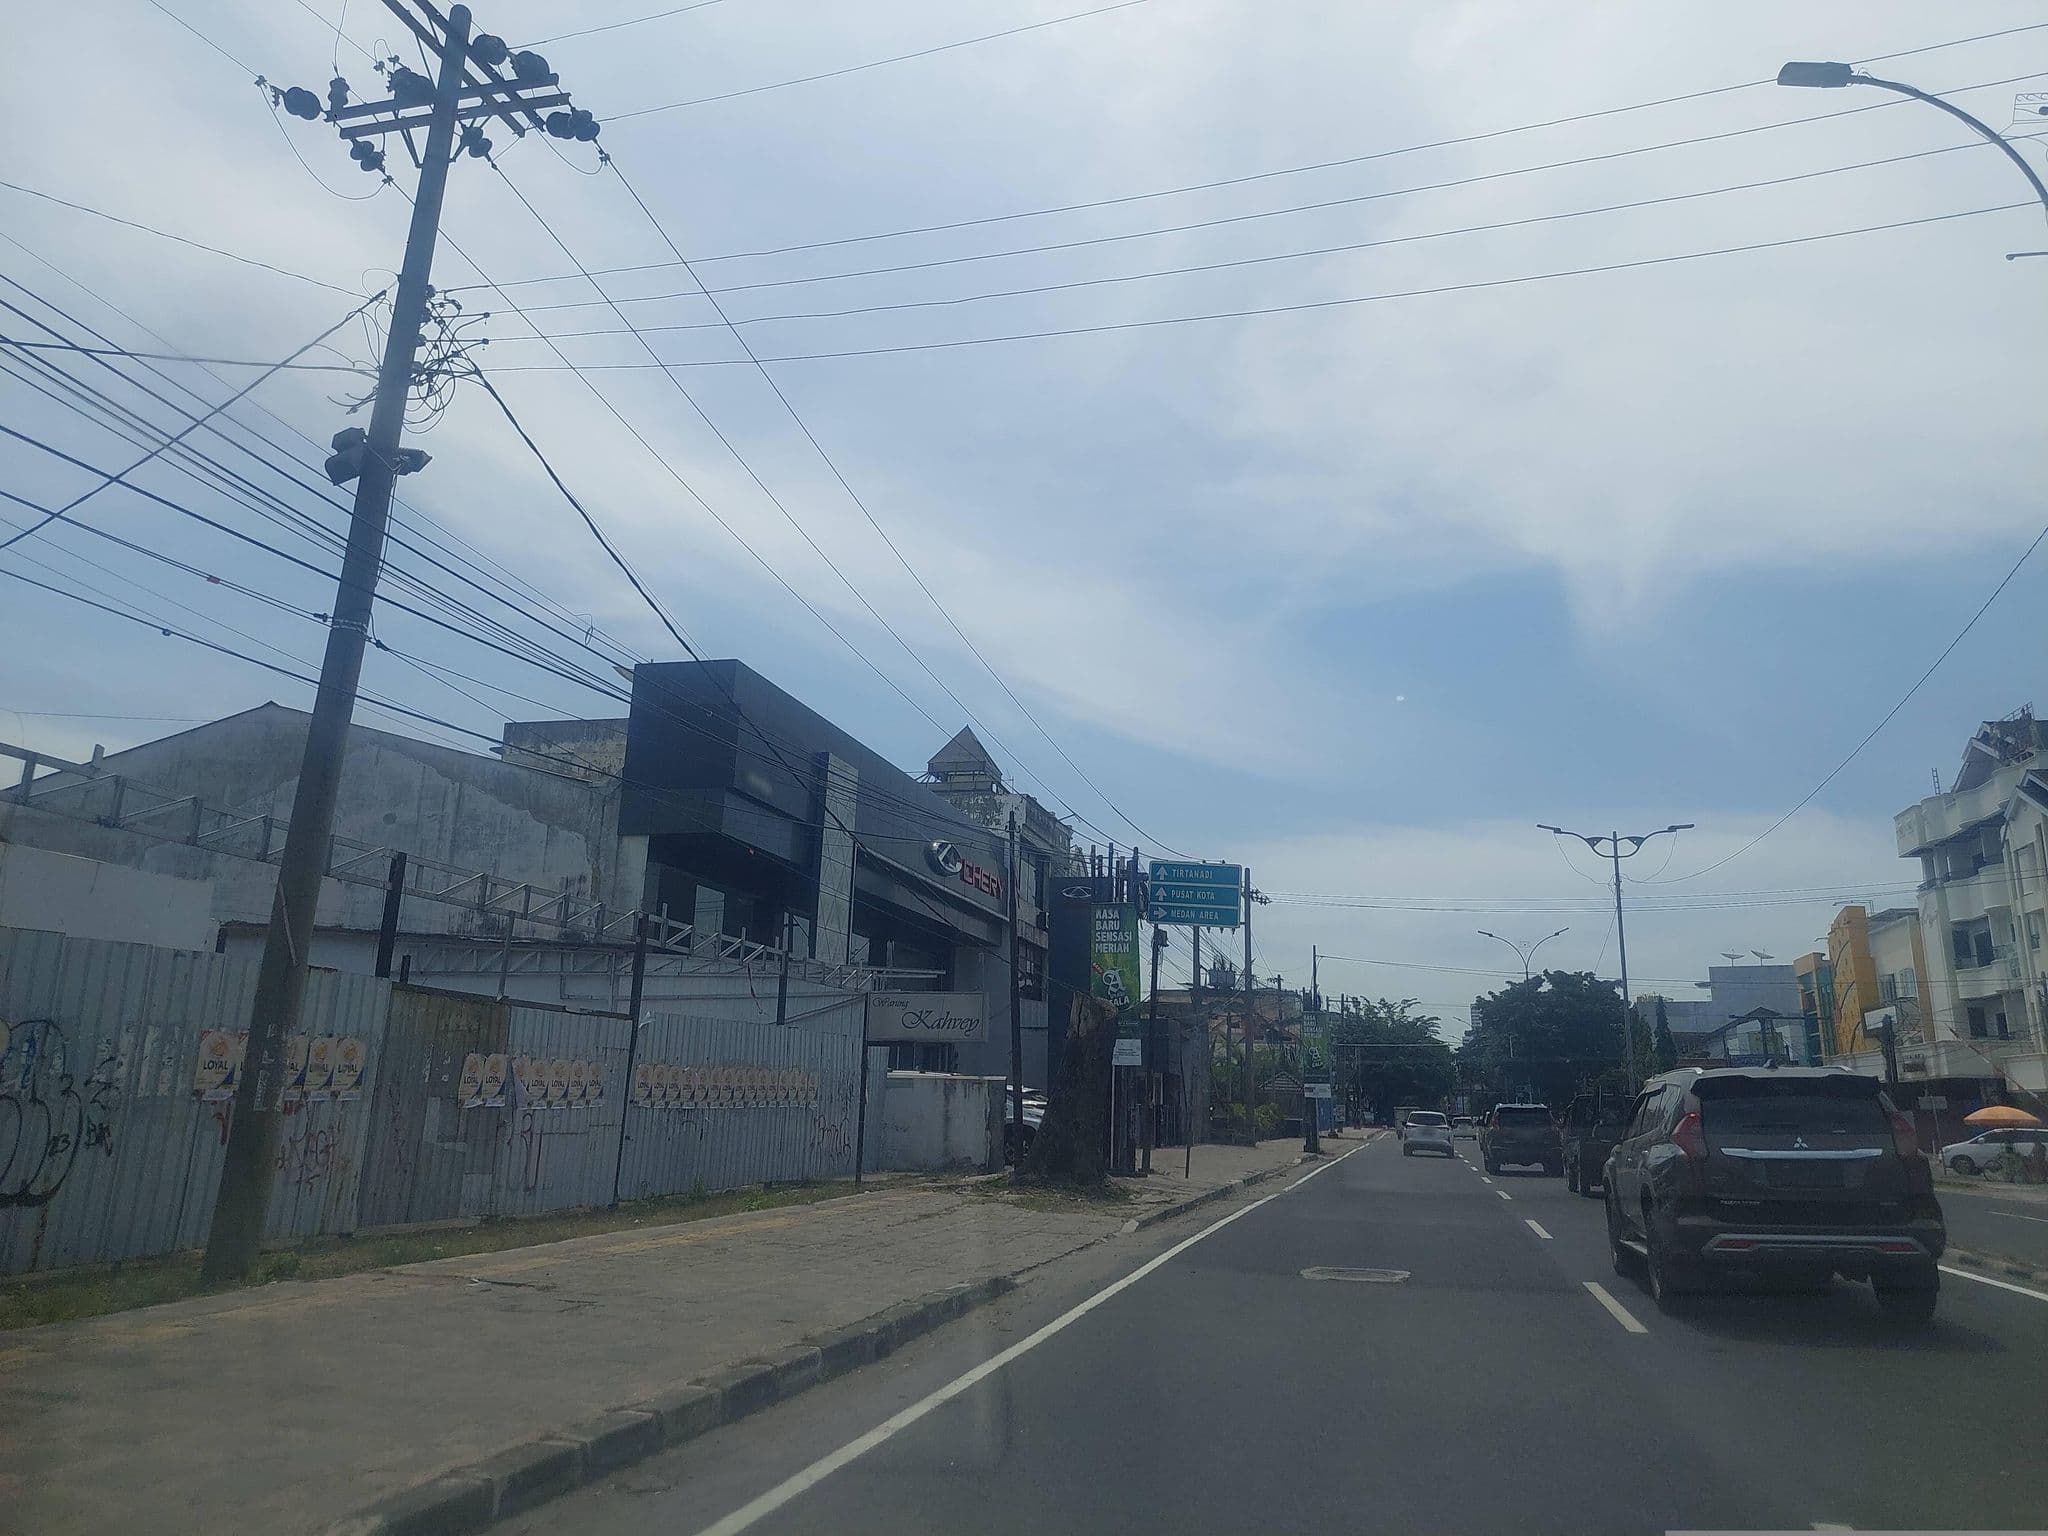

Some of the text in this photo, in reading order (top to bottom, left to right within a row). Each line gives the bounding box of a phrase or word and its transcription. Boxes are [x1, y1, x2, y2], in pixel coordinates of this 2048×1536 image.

[963, 859, 1003, 899] CHERY
[1172, 869, 1213, 879] TIRTANADI
[1171, 889, 1215, 900] PUSAT KOTA
[1171, 909, 1219, 920] MEDAN AREA
[1096, 920, 1120, 931] BARU
[1096, 931, 1132, 942] SENSASI
[1096, 942, 1130, 953] MERIAH
[901, 1010, 980, 1037] Kahvey
[203, 1060, 229, 1070] LOYAL
